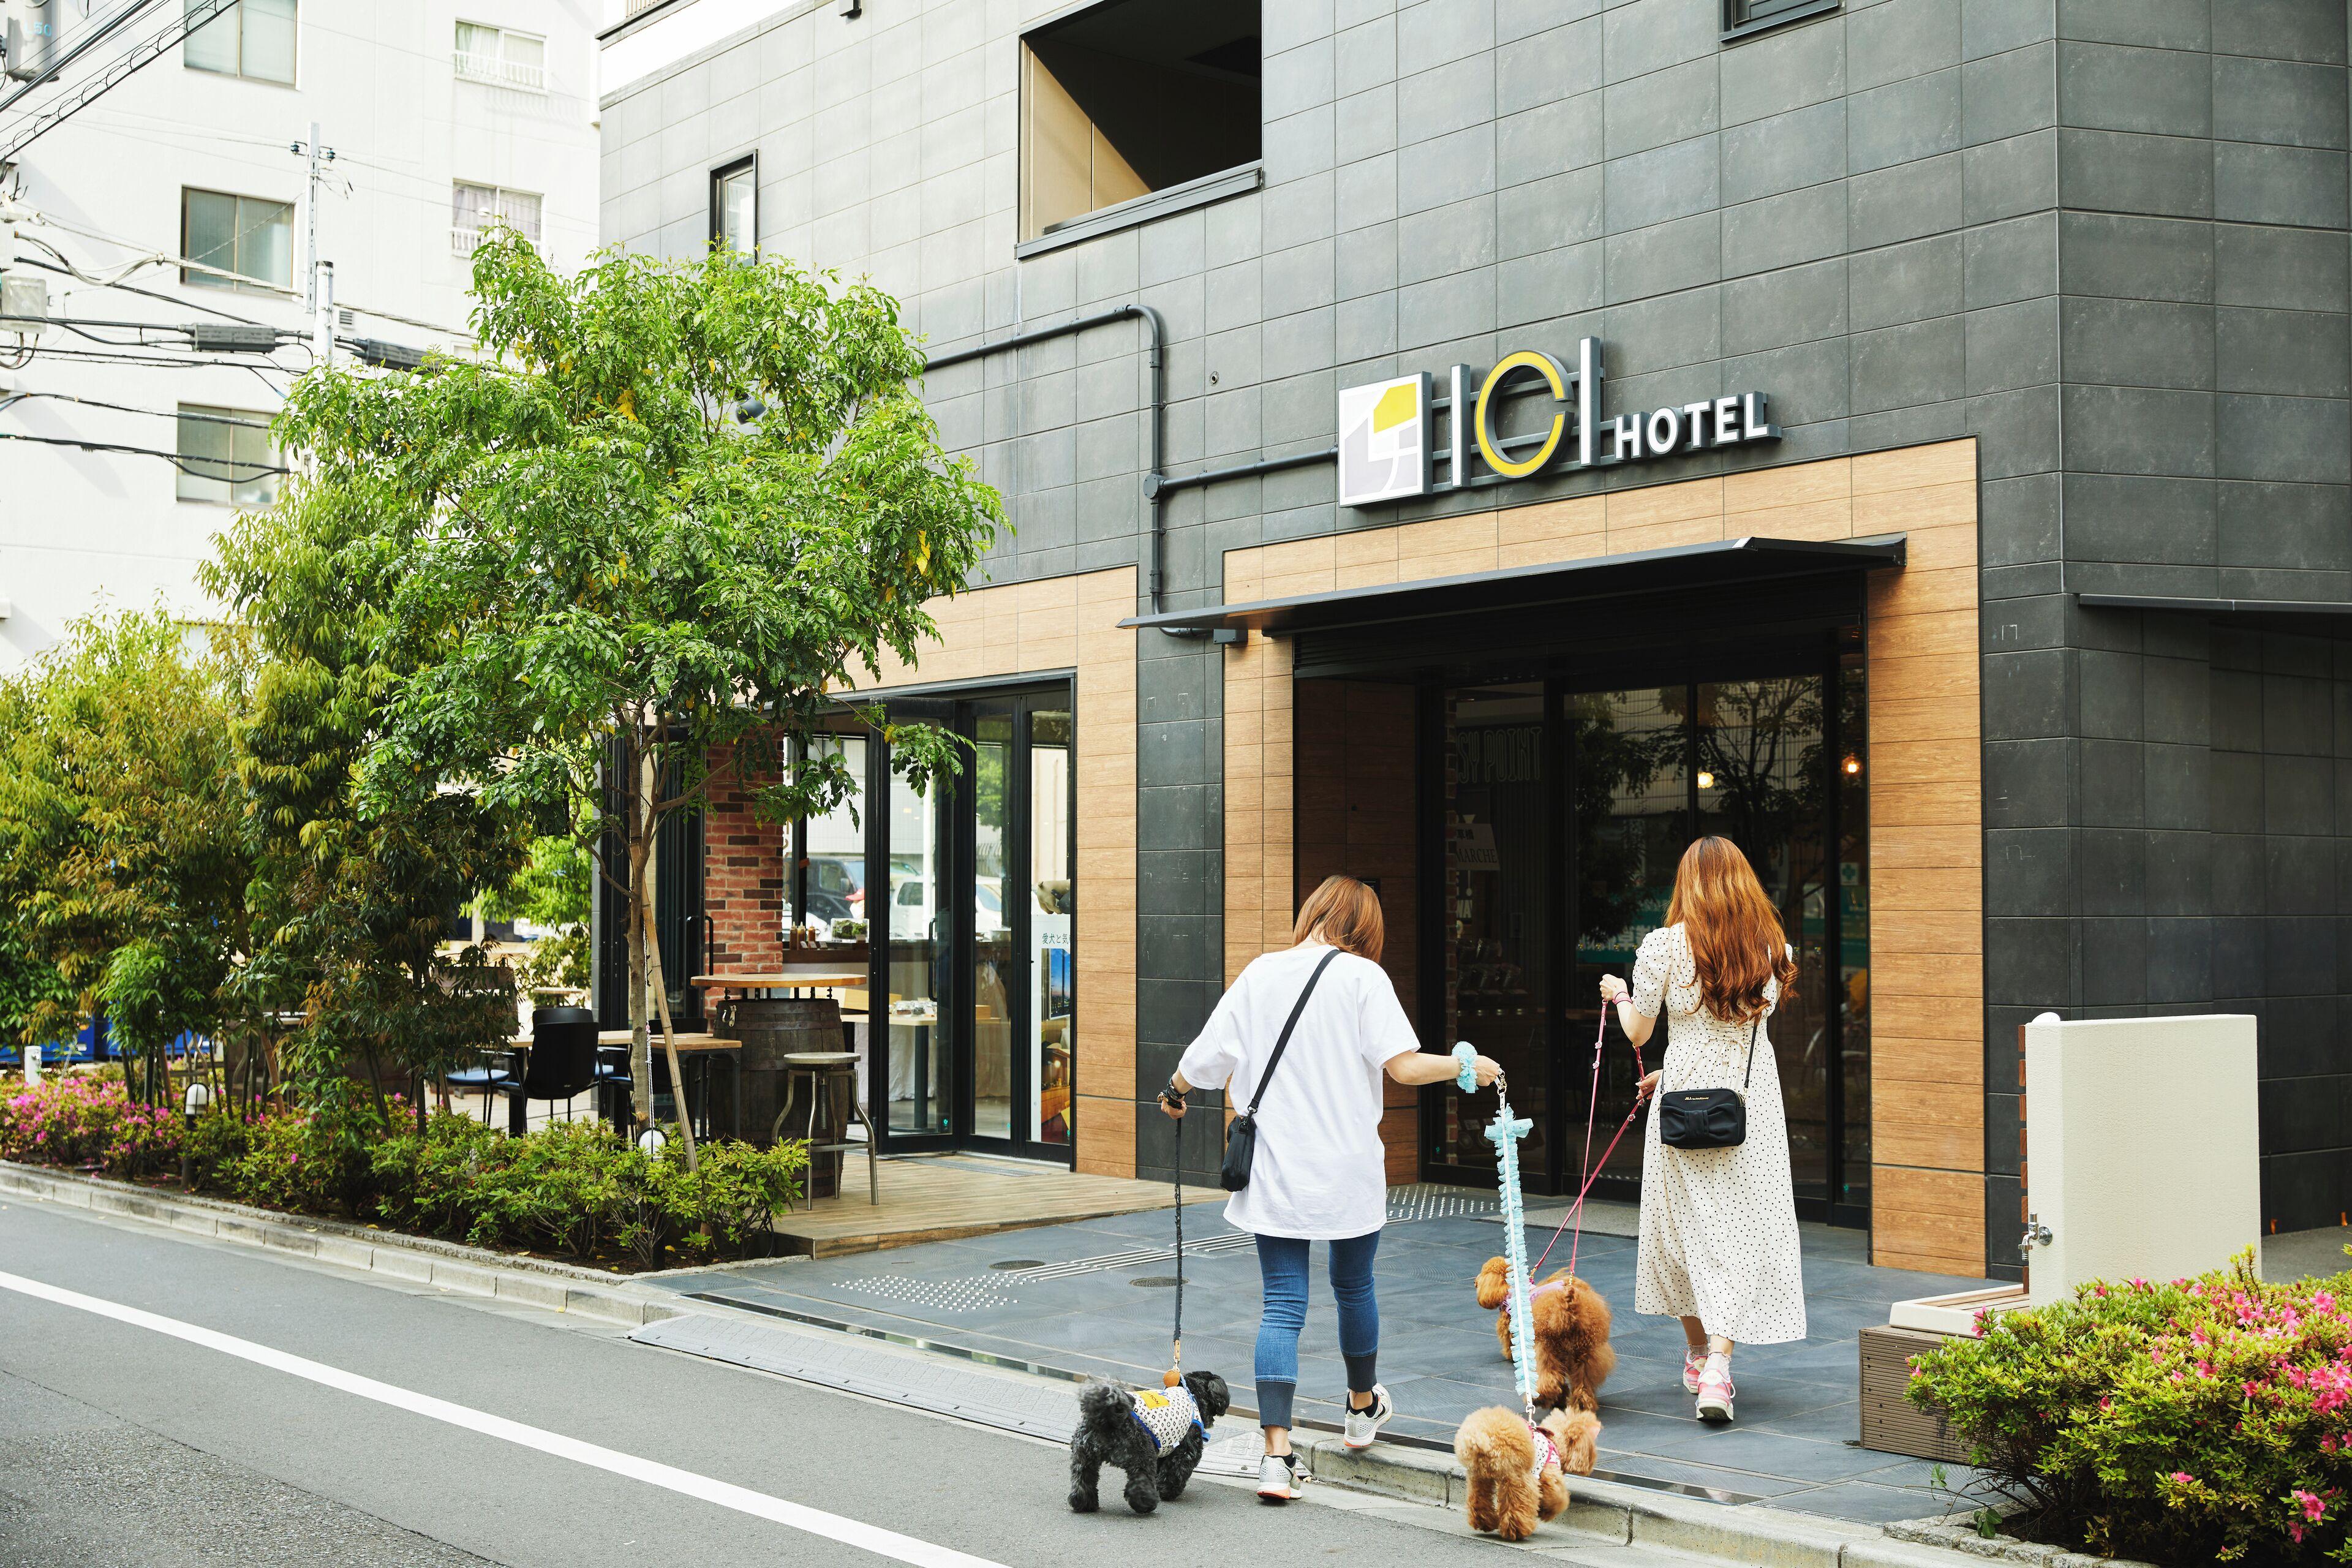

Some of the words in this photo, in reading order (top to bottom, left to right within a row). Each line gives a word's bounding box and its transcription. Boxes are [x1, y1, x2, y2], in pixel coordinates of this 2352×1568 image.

[1450, 335, 1600, 488] ICI
[1615, 391, 1780, 461] HOTEL
[1484, 726, 1543, 783] POINT
